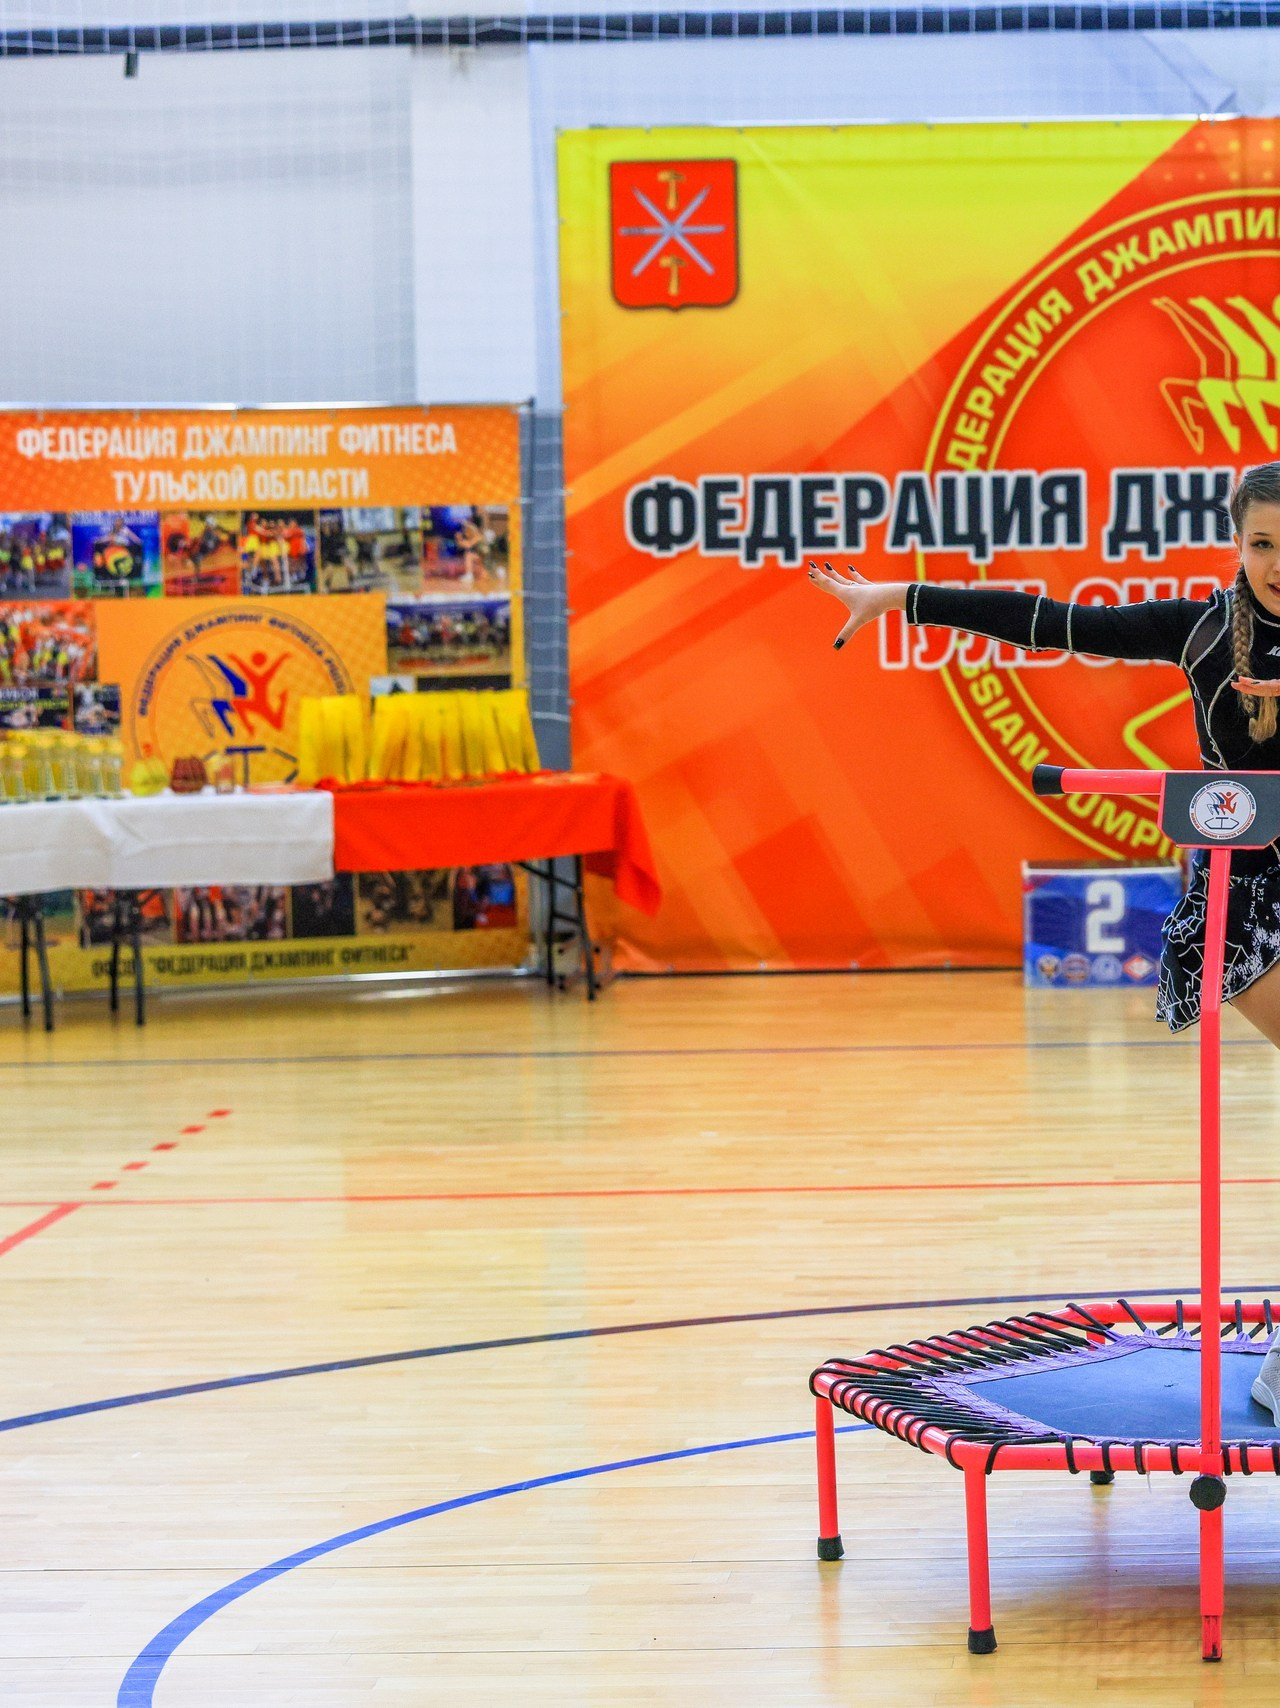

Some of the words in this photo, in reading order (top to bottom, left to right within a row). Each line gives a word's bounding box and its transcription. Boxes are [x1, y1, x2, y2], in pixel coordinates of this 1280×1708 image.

[946, 288, 1074, 470] ДЕРАЦИЯ
[16, 425, 177, 462] ФЕДЕРАЦИЯ
[183, 424, 334, 461] ДЖАМПИНГ
[338, 422, 457, 457] ФИТНЕСА
[112, 464, 249, 503] ТУЛЬСКОЙ
[253, 468, 370, 501] ОБЛАСТИ
[626, 470, 1087, 563] ФЕДЕРАЦИЯ
[1086, 879, 1126, 954] 2
